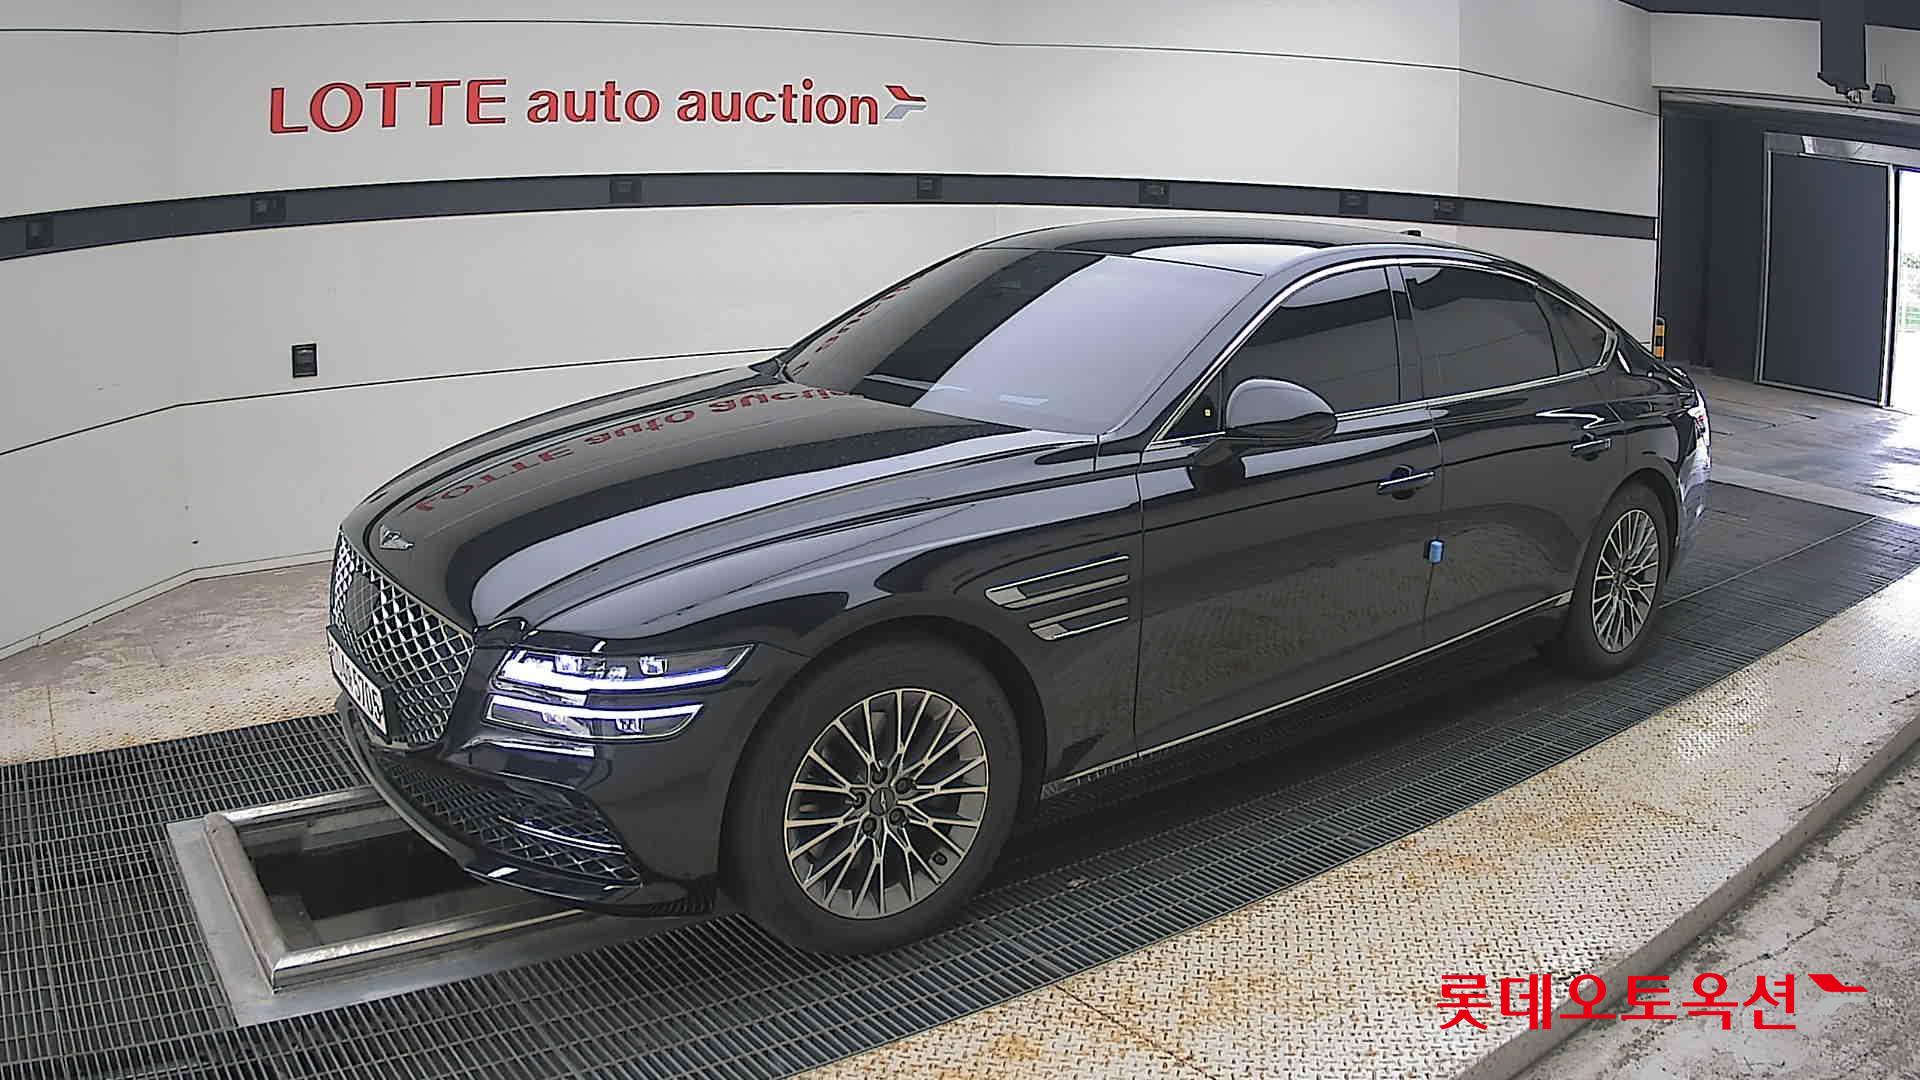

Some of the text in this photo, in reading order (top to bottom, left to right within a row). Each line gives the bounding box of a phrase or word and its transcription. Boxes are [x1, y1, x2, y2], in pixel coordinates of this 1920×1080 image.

[269, 79, 879, 134] LOTTE auto auction
